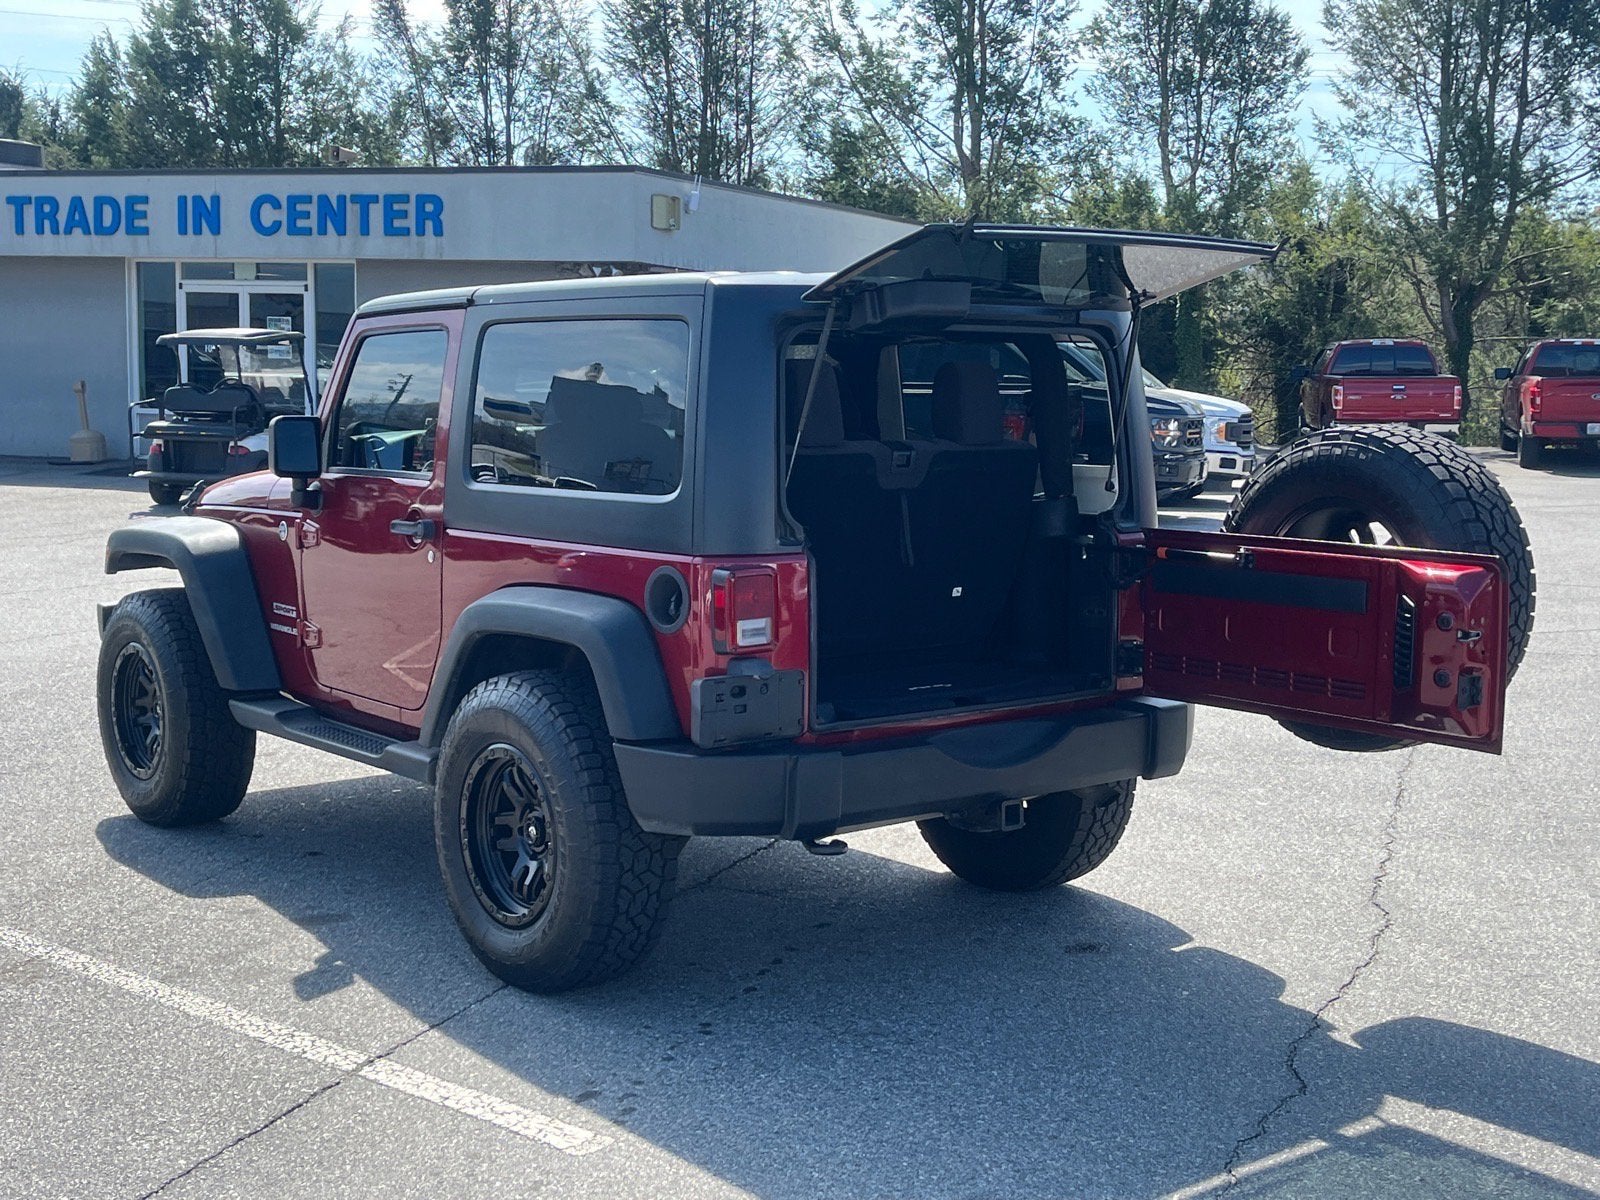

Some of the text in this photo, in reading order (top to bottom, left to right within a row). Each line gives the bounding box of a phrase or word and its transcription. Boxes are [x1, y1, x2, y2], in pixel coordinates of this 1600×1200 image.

[6, 193, 444, 237] TRADE IN CENTER
